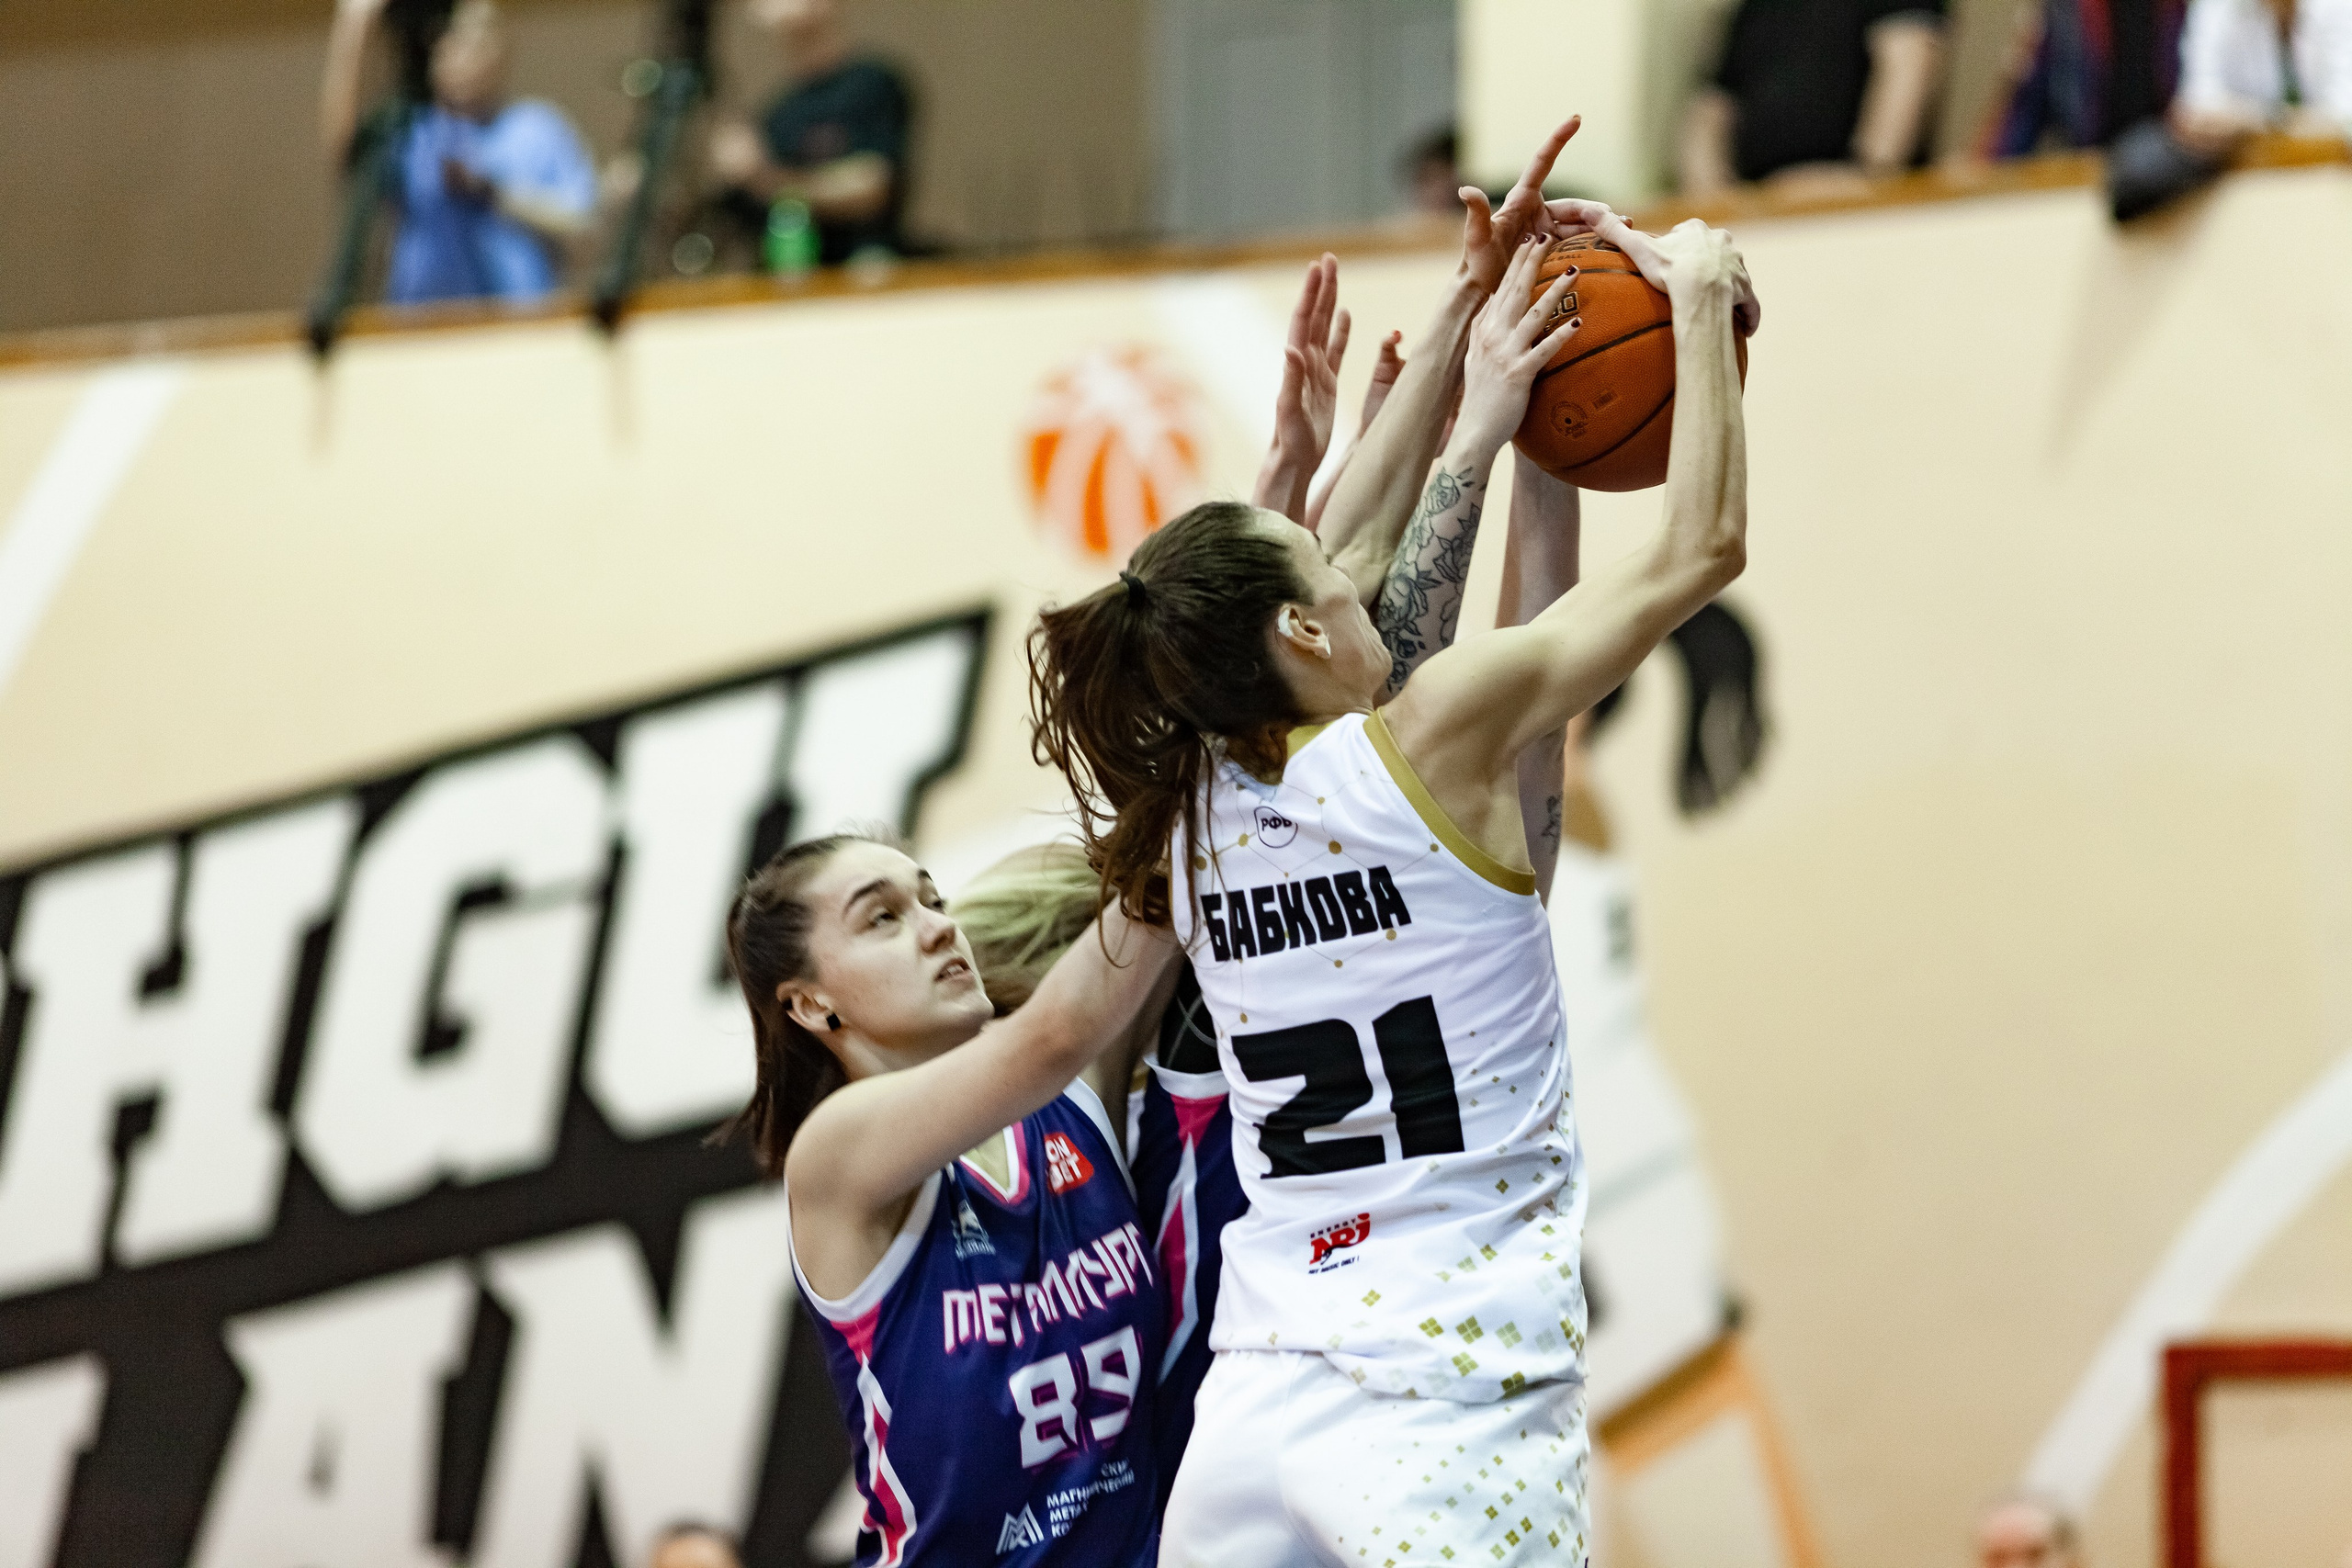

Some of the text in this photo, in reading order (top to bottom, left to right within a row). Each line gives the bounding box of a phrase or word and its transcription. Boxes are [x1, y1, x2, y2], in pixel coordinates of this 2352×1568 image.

[1200, 864, 1412, 963] БАБКОВА
[1231, 995, 1465, 1179] 21
[1009, 1324, 1143, 1471] 89
